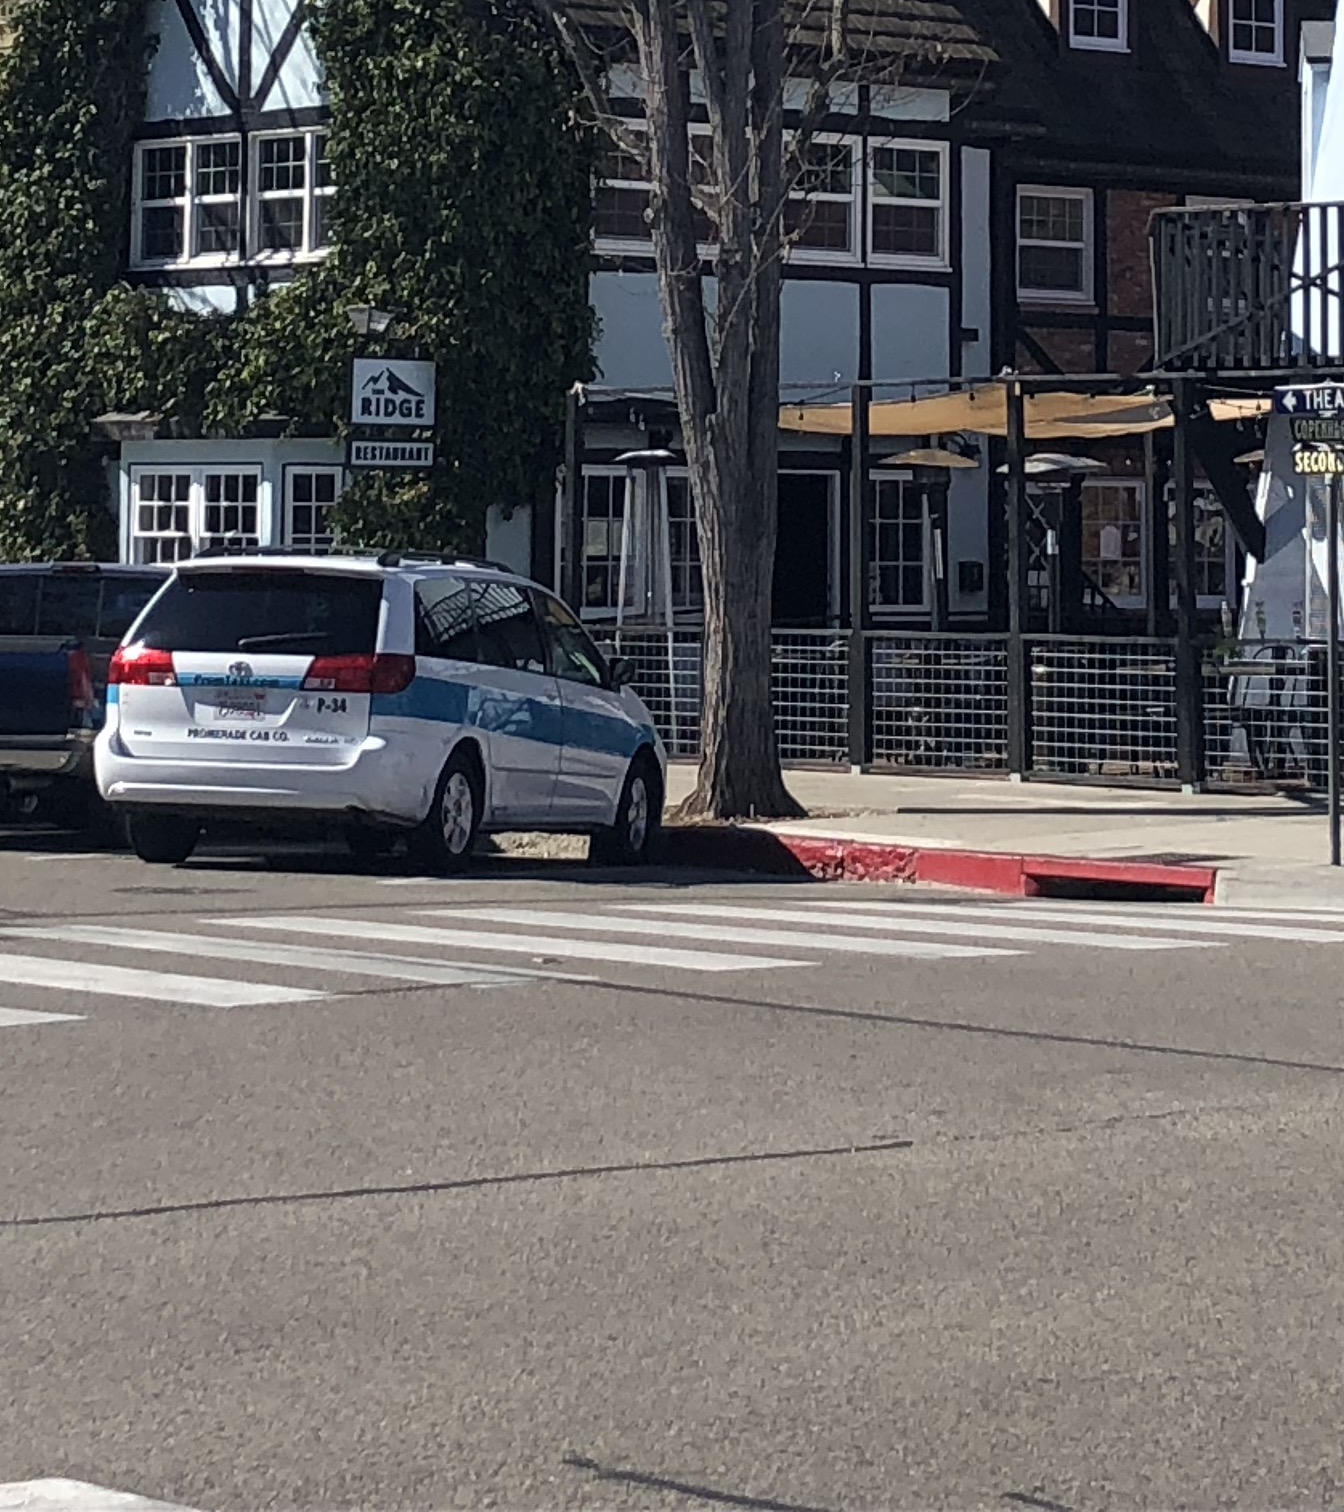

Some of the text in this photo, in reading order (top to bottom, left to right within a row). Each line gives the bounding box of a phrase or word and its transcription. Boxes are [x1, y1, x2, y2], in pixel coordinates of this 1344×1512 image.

[360, 397, 425, 419] RIDGE
[355, 445, 430, 461] RESTAURANT
[1294, 451, 1344, 473] SECOND
[317, 698, 347, 713] P-34
[187, 728, 290, 742] PROMENADE CAB CO.
